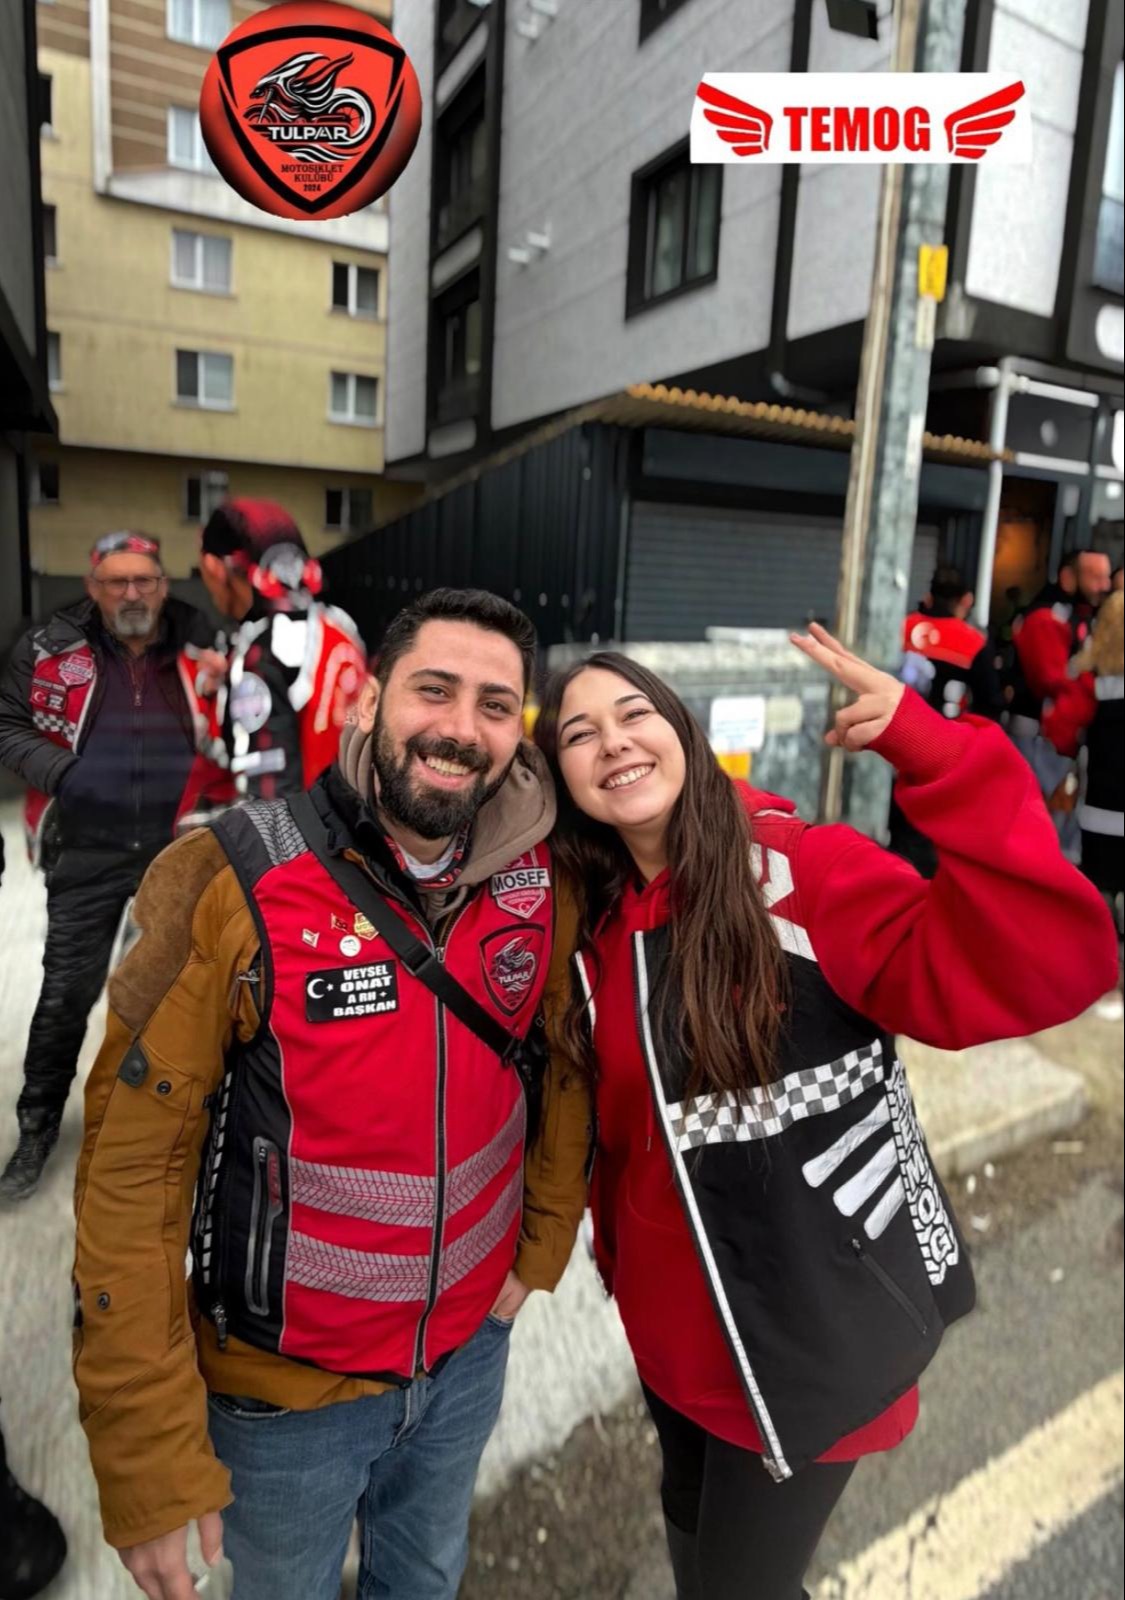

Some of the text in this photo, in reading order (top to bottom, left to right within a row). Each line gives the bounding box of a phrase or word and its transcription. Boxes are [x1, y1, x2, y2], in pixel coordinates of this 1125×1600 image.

[493, 870, 546, 892] MOSEF
[343, 965, 388, 980] VEYSEL
[341, 976, 392, 992] ONAT
[347, 994, 357, 1004] A
[358, 991, 377, 1003] RH
[333, 1000, 396, 1016] BAŞKAN
